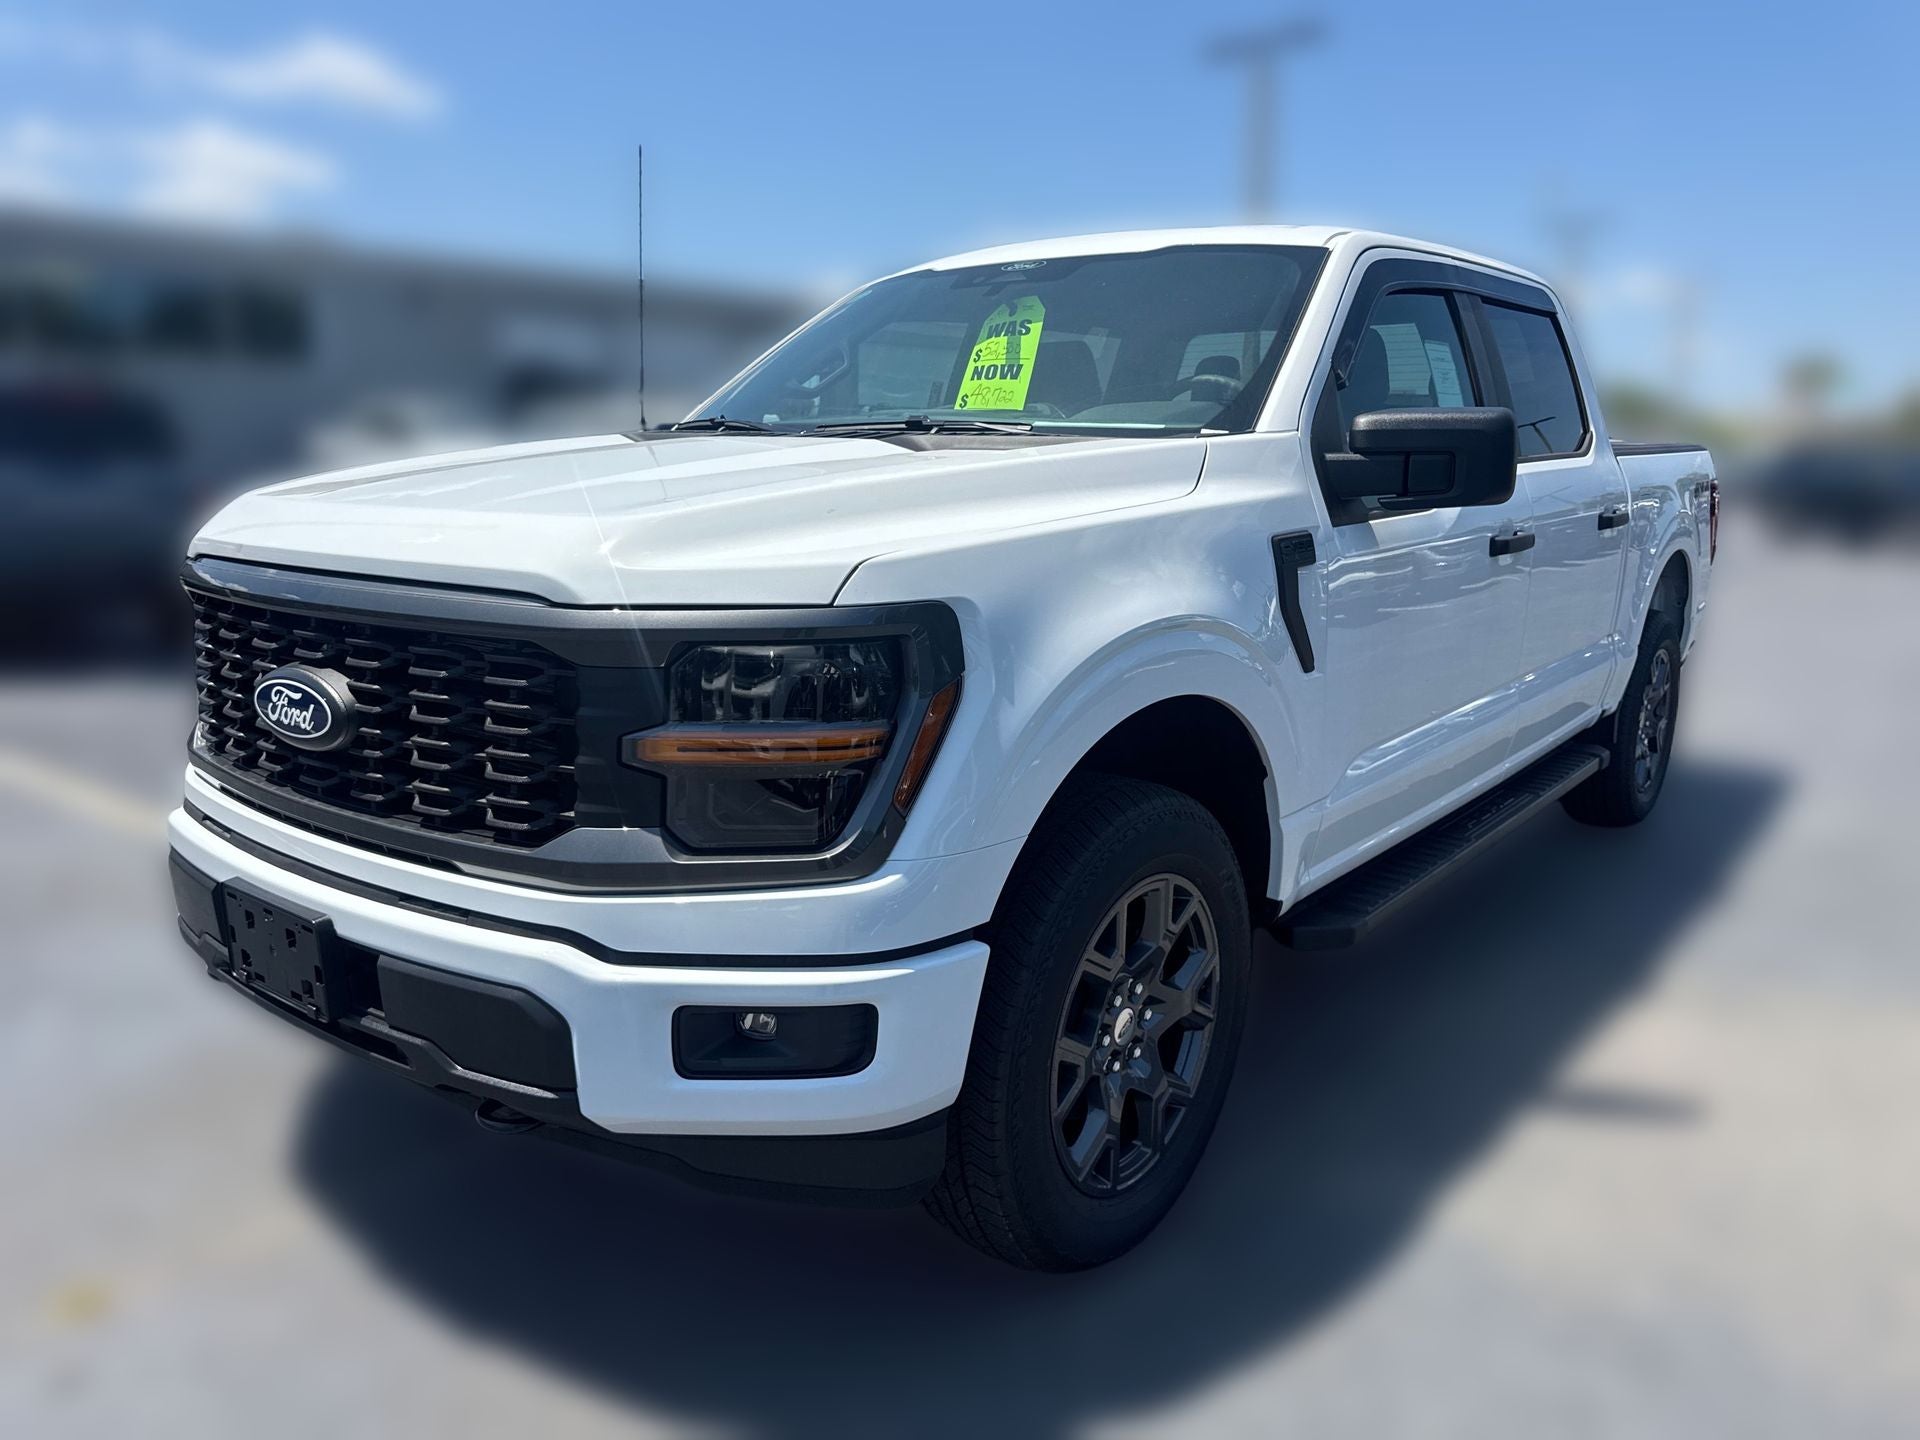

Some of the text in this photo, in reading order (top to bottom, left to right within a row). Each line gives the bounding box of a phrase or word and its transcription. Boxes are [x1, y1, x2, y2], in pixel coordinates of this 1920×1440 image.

[987, 319, 1033, 339] WAS
[970, 364, 1024, 381] NOW
[267, 685, 315, 731] Ford
